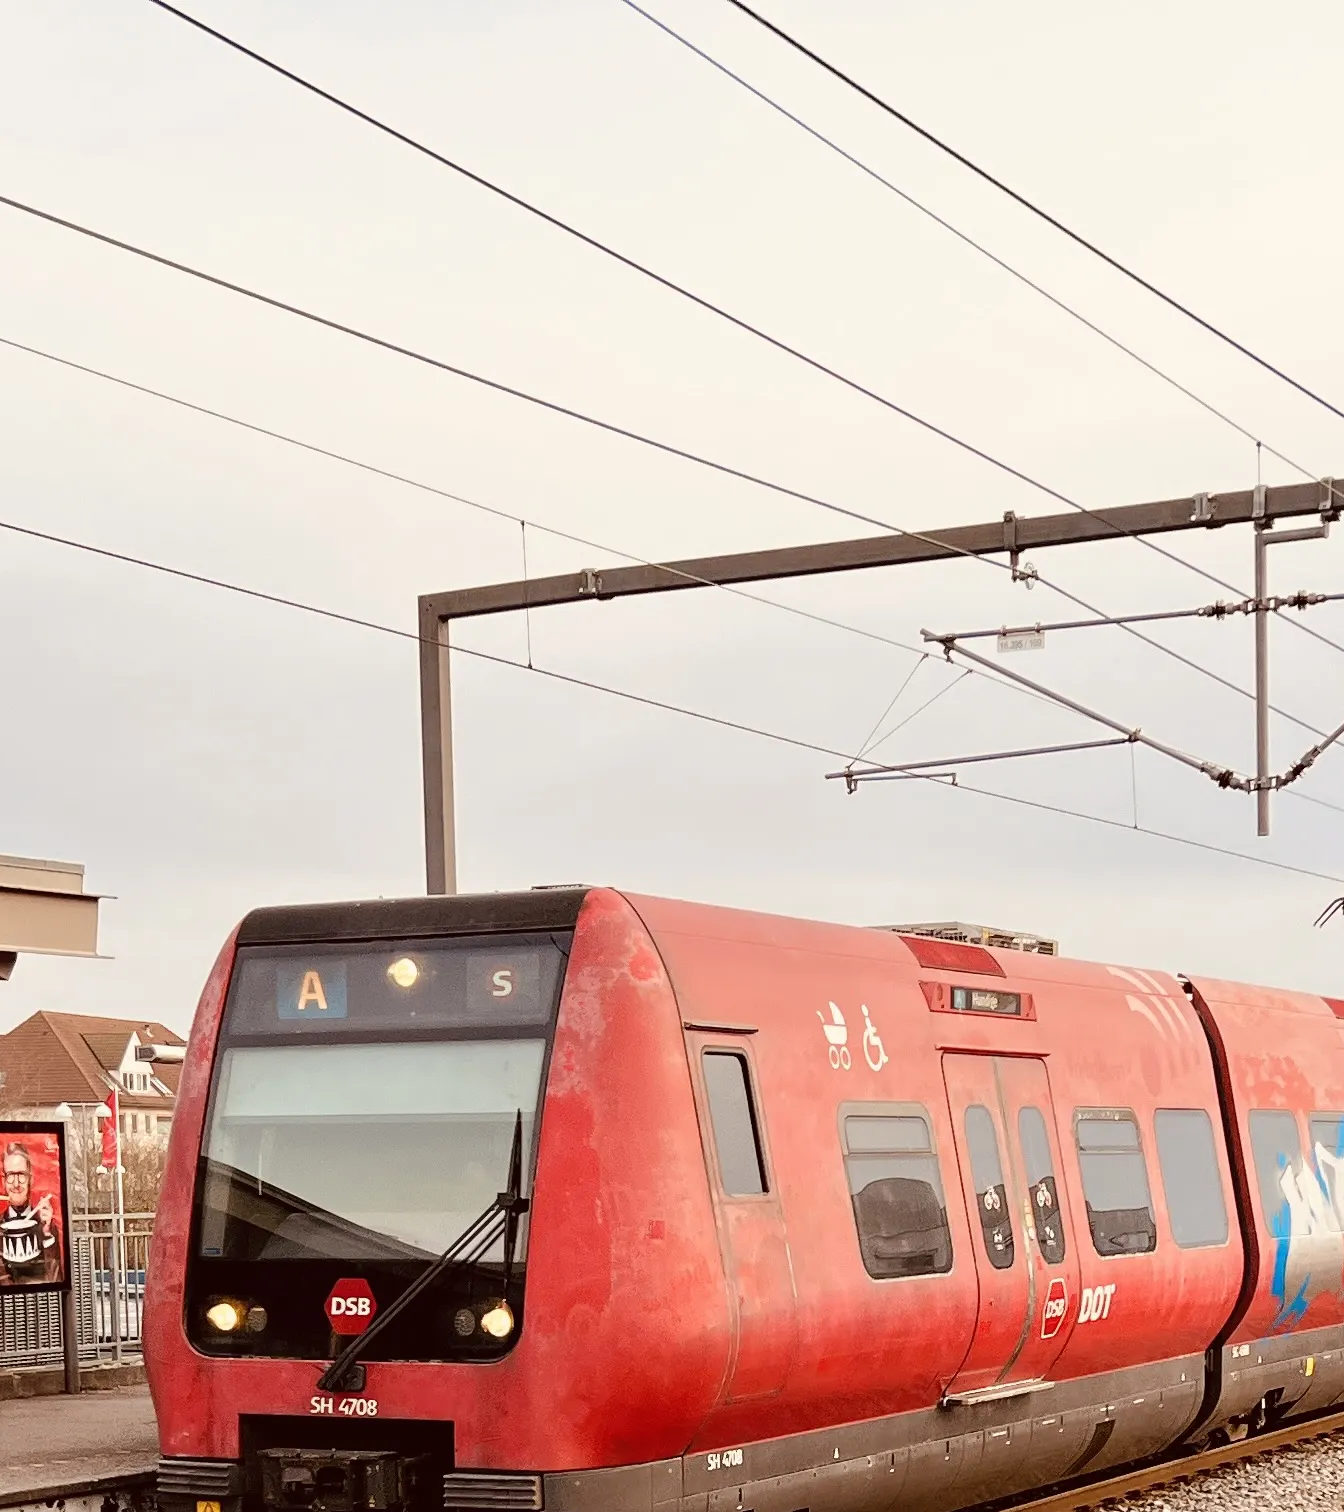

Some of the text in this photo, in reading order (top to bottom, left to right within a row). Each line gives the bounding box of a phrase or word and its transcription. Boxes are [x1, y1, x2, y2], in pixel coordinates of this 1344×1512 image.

[297, 970, 328, 1010] A
[330, 1297, 371, 1316] DSB
[1045, 1284, 1114, 1324] DSB DOT
[310, 1396, 378, 1416] SH 4708
[707, 1448, 743, 1471] SH 4708
